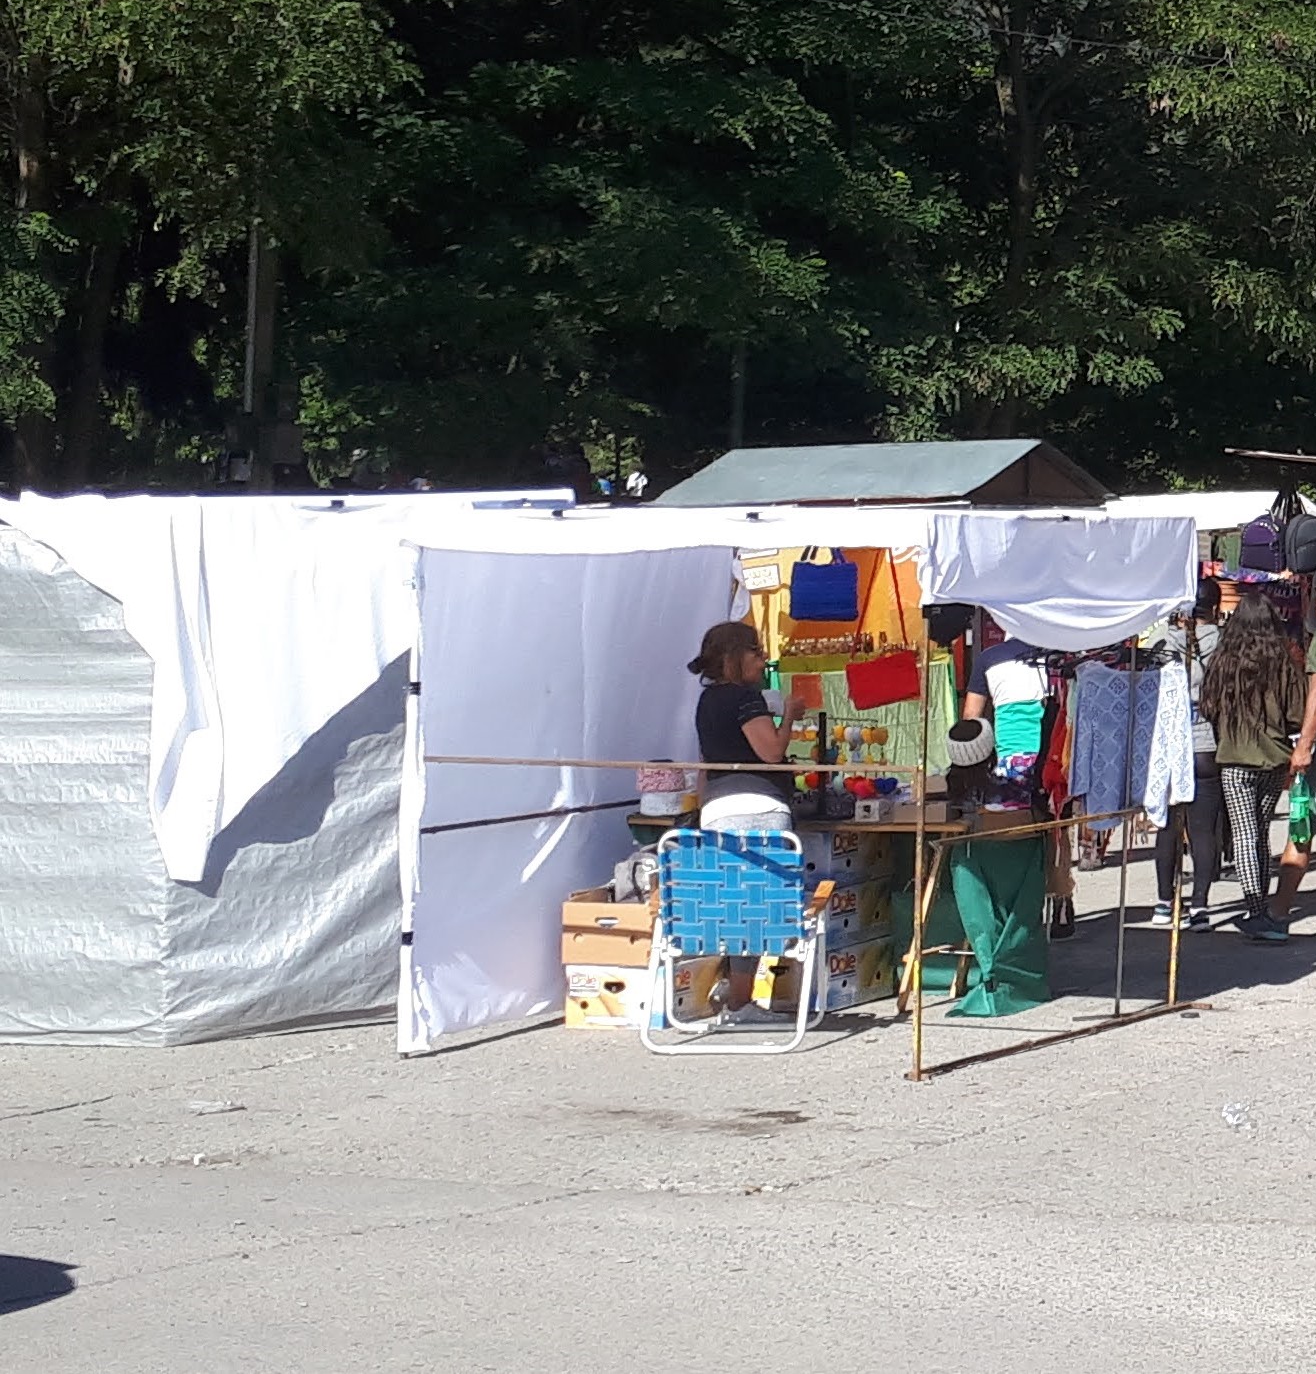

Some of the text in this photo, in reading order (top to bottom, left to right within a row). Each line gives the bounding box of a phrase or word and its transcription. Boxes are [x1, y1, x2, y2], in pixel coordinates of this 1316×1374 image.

[833, 832, 858, 852] Dole
[831, 891, 856, 911] Dole
[830, 952, 856, 974] Dole
